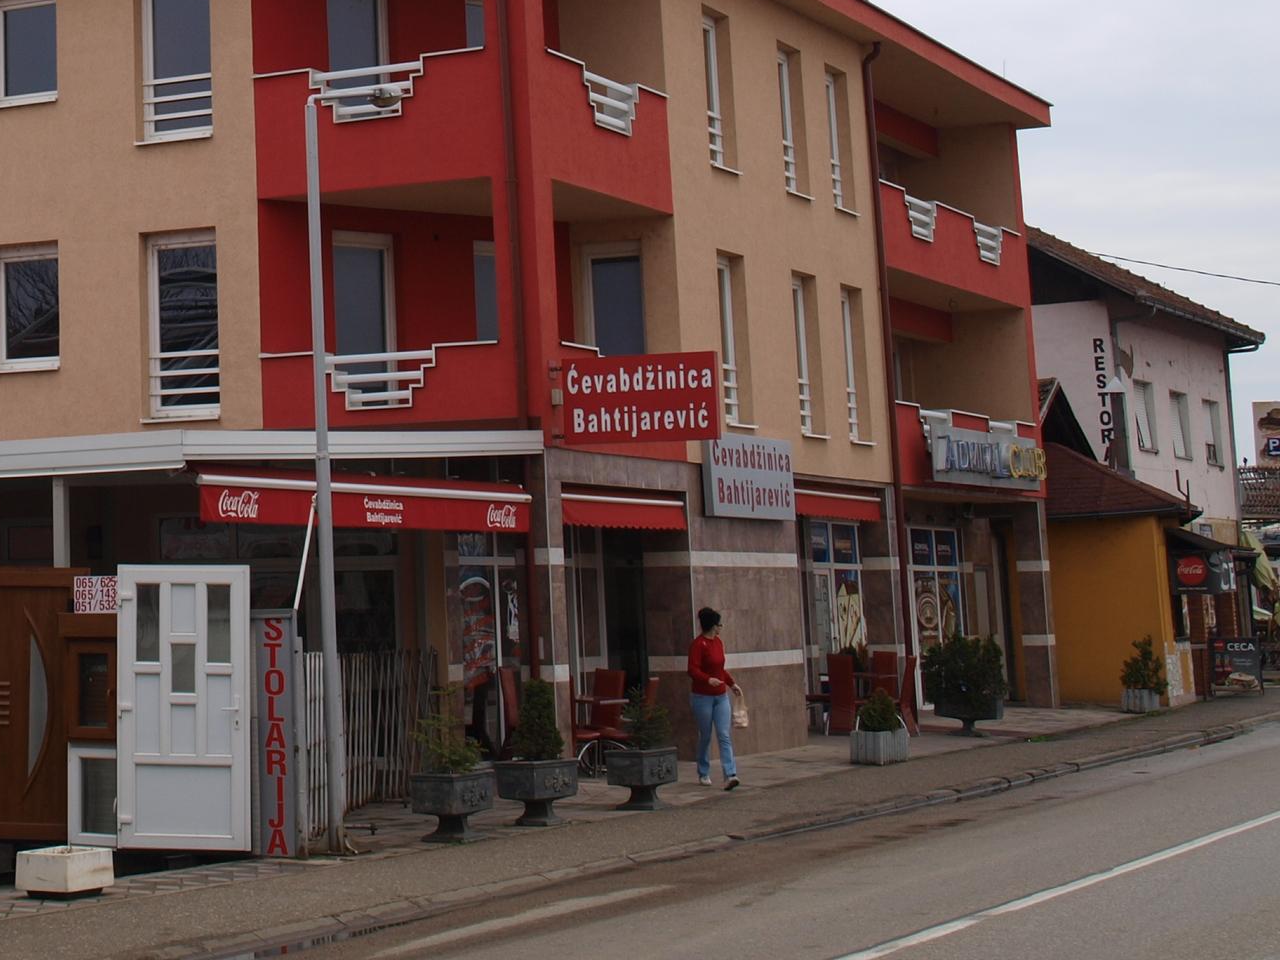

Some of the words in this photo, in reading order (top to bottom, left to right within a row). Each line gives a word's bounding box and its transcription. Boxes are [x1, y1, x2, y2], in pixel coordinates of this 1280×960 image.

[567, 363, 713, 395] Ćevabdžinica
[573, 402, 709, 438] Bahtijarević
[719, 478, 791, 512] Bahtijarević
[1227, 642, 1255, 651] CECA
[263, 618, 288, 855] STOLARIJA
